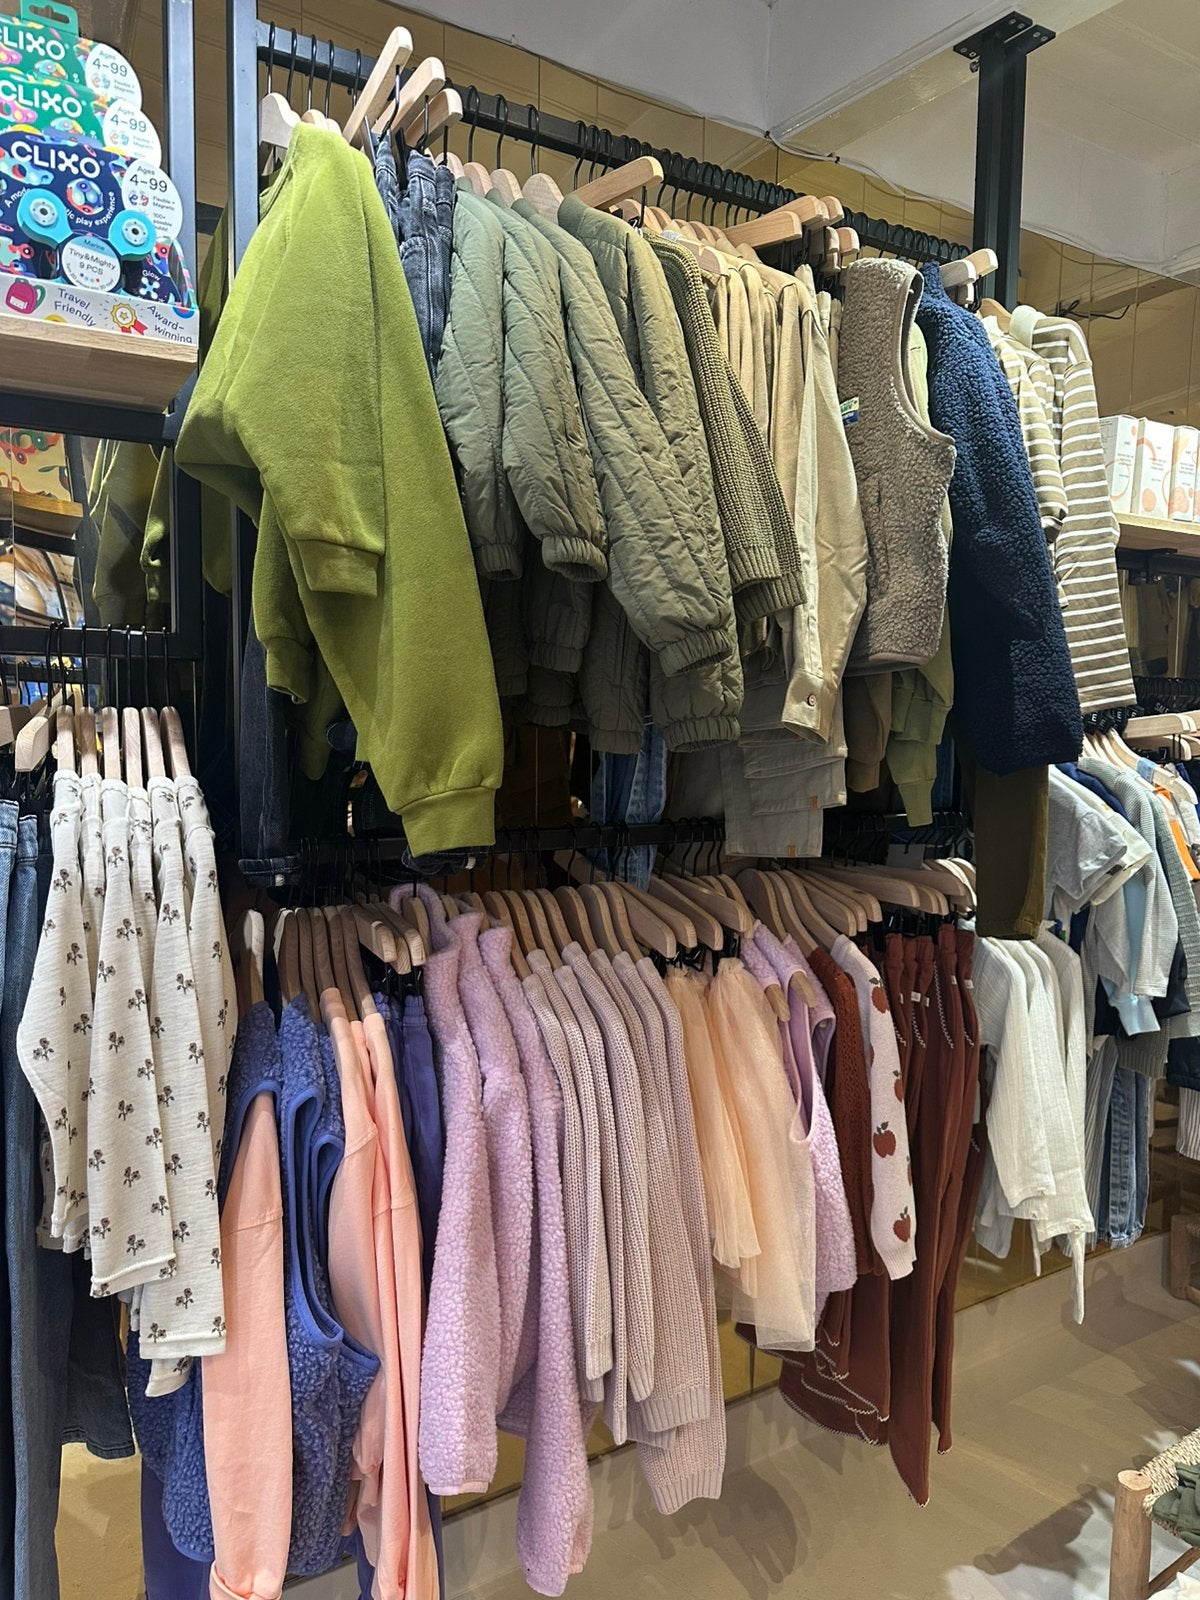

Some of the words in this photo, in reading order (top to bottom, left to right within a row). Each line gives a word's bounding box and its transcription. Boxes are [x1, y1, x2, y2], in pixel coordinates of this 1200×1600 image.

[0, 25, 65, 61] LIXO
[99, 50, 116, 60] Ages
[92, 58, 128, 77] 4-99
[0, 79, 83, 118] CLIXO
[110, 113, 147, 133] 4-99
[11, 140, 101, 179] CLIXO
[137, 165, 156, 176] Ages
[129, 173, 168, 193] 4-99
[4, 199, 13, 208] A
[11, 186, 29, 202] mod
[76, 217, 94, 228] play
[94, 191, 116, 226] experience
[69, 247, 116, 270] Tiny&Mighty
[86, 264, 104, 275] PCS
[142, 269, 161, 281] Glow
[58, 287, 91, 310] Travel
[54, 300, 97, 327] Friendly
[147, 305, 185, 331] Award-
